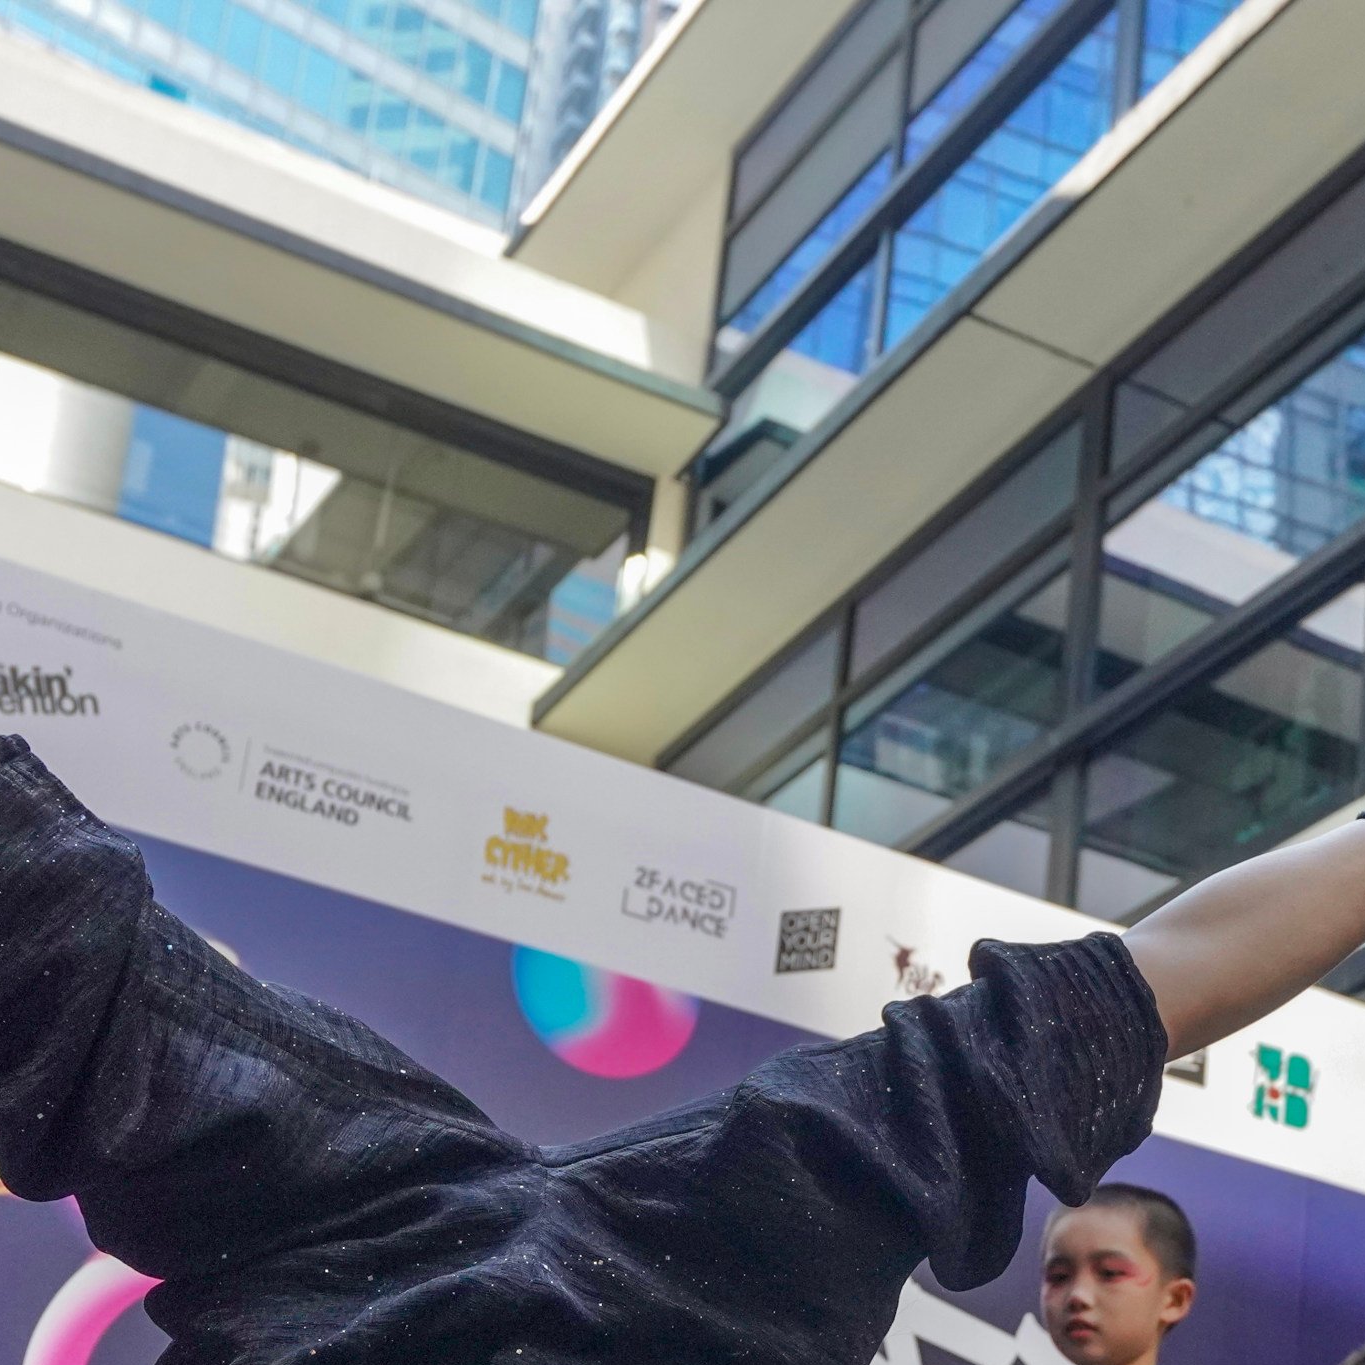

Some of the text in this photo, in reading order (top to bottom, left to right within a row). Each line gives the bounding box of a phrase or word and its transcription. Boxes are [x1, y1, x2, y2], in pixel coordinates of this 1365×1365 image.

[259, 760, 316, 792] ARTS
[322, 778, 413, 822] COUNCIL
[254, 780, 360, 827] ENGLAND
[786, 910, 837, 932] OPEN
[781, 929, 835, 952] YOUR
[778, 950, 834, 971] MIND
